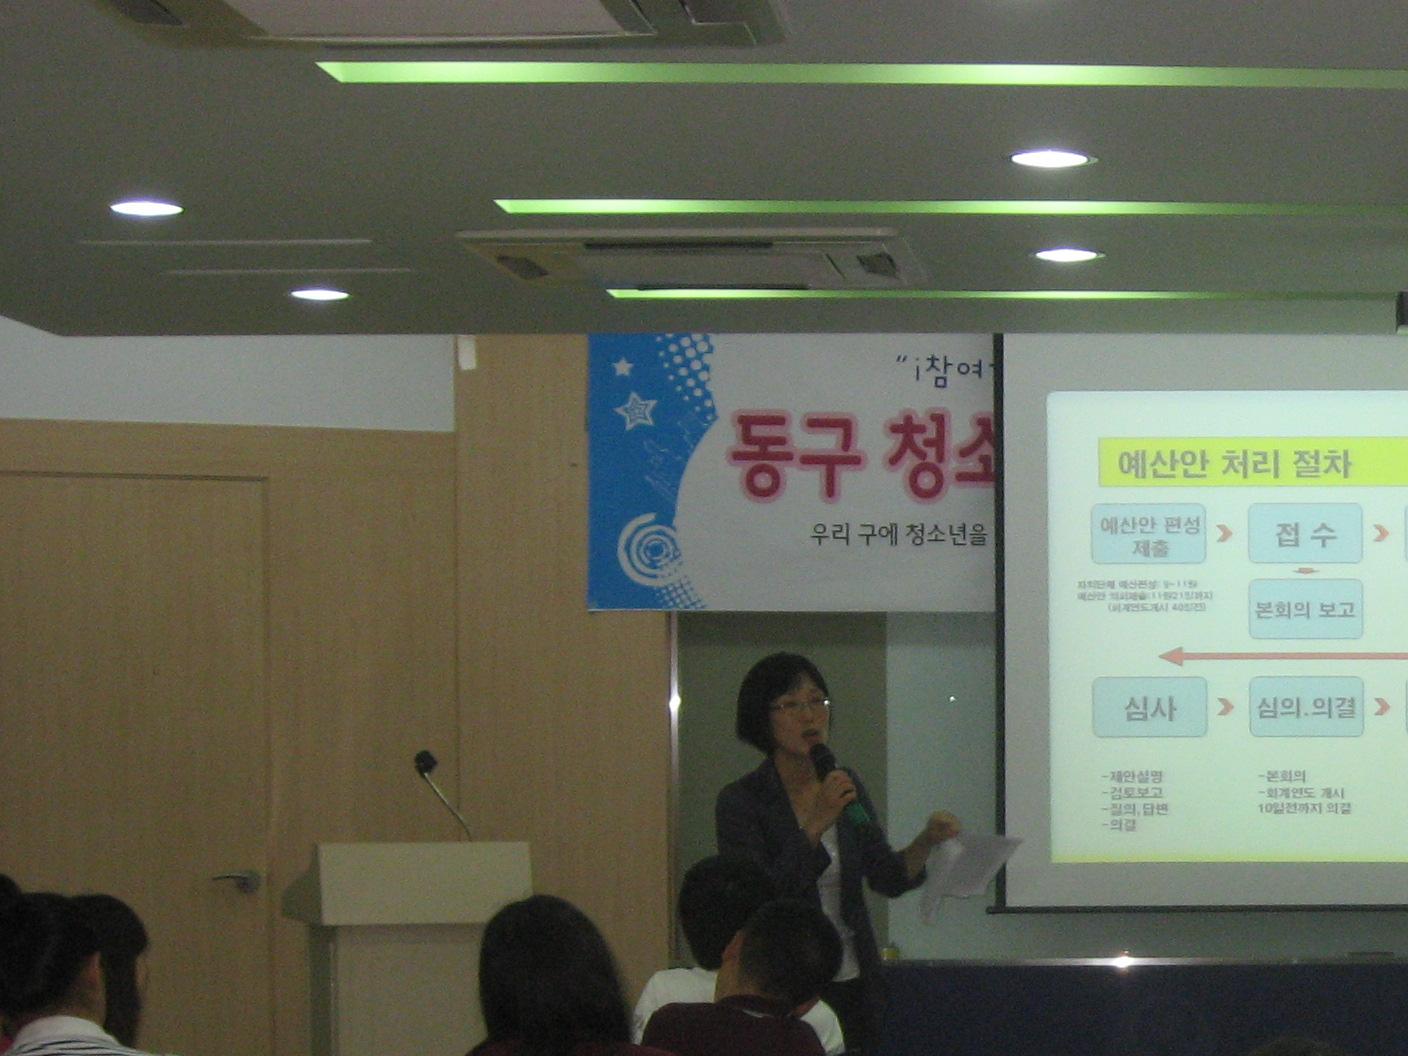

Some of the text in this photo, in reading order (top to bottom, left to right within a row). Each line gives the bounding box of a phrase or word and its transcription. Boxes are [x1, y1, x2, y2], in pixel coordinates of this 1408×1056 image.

[730, 411, 863, 500] 동구
[1118, 449, 1352, 479] 예산안 처리 절차
[811, 522, 988, 546] 우리 구에 청소년을
[1100, 516, 1201, 535] 예산안 편성
[1275, 522, 1338, 548] 접 수
[1132, 539, 1170, 558] 제출
[1255, 601, 1356, 619] 본회의 보고
[1124, 696, 1177, 722] 심사
[1257, 697, 1356, 719] 심의.의결
[1258, 769, 1307, 783] -본회의
[1327, 802, 1352, 815] 의결
[1101, 819, 1137, 832] -의결
